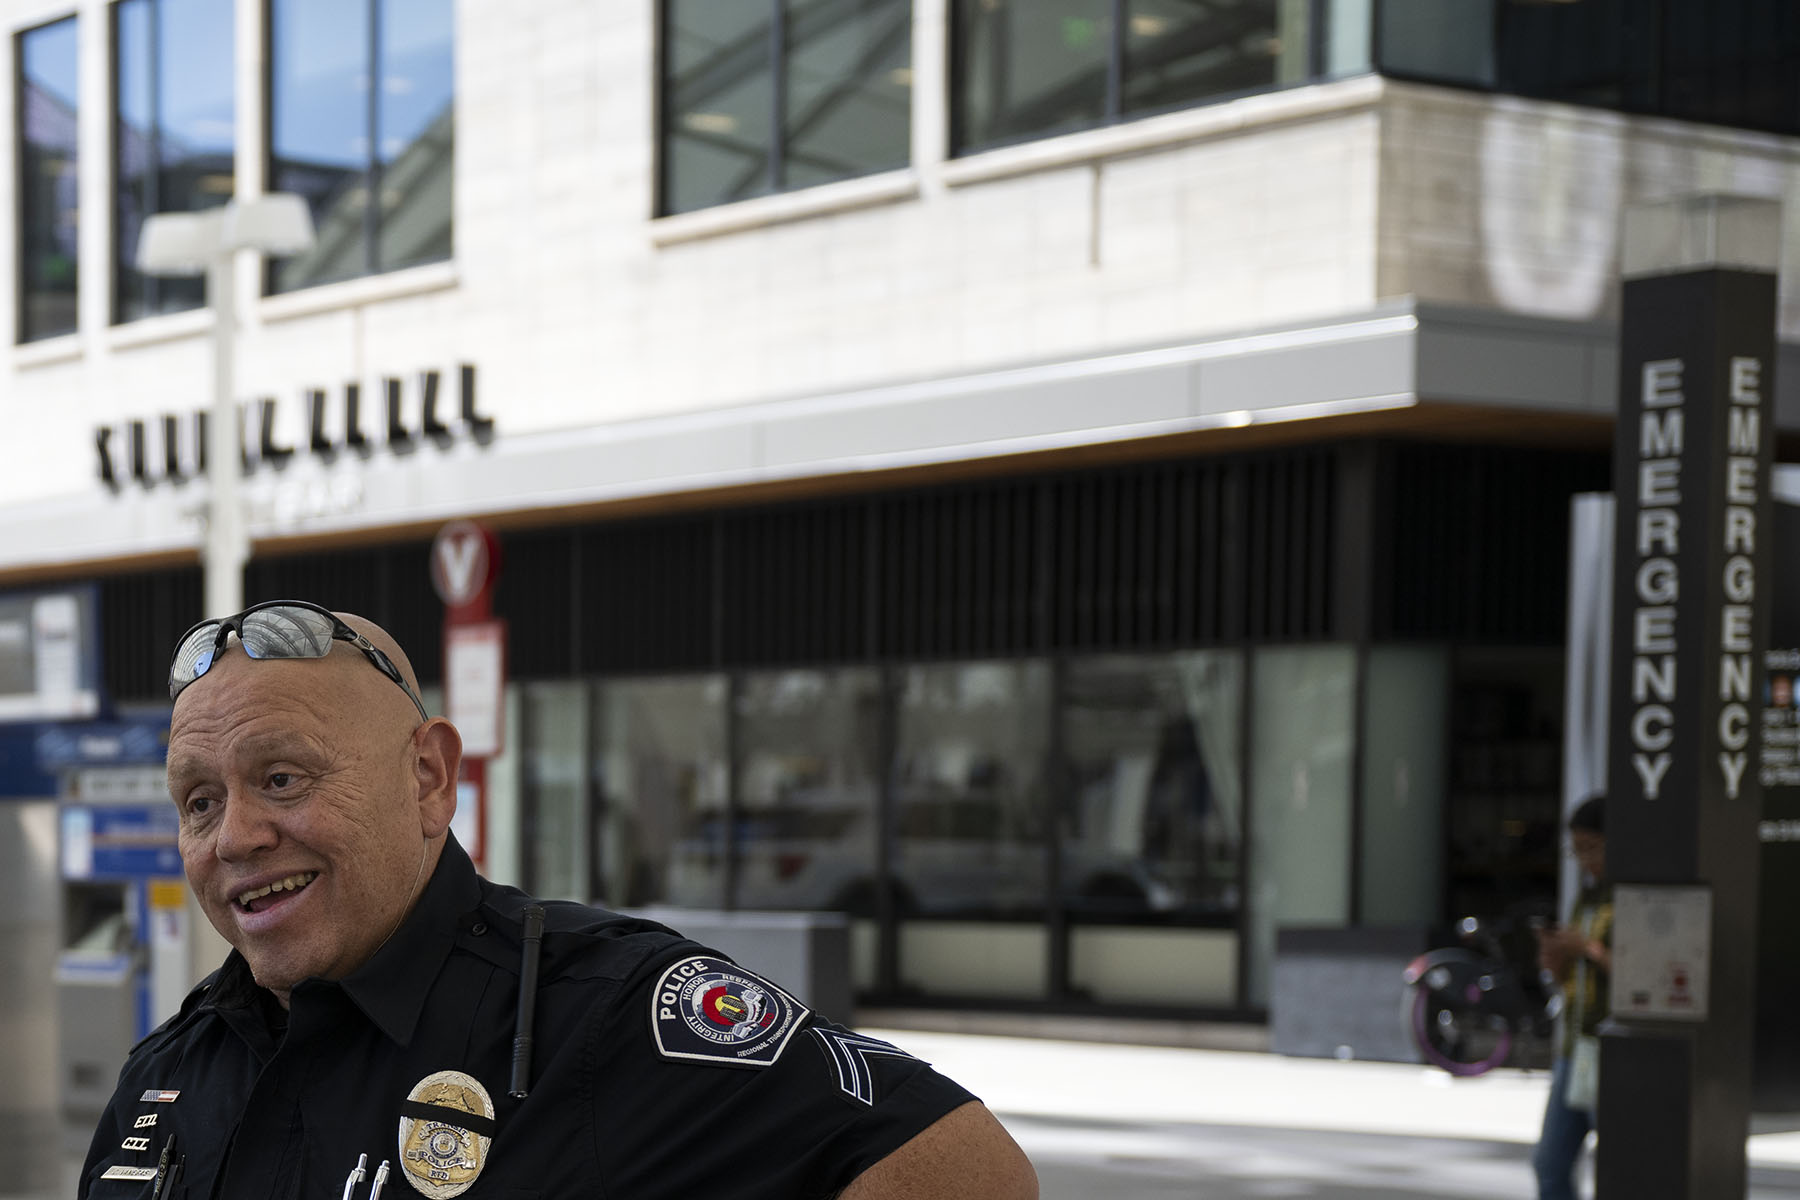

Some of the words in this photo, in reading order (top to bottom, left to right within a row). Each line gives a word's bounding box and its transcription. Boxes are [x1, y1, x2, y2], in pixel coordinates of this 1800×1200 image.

[438, 537, 482, 599] V
[1630, 357, 1686, 800] EMERGENCY
[1717, 355, 1762, 800] EMERGENCY
[660, 961, 708, 1020] POLICE
[683, 977, 707, 1001] HONOR
[722, 973, 766, 995] RESPECT
[686, 1015, 735, 1042] INTEGRITY
[737, 1041, 769, 1057] REGIONAL
[420, 1151, 464, 1167] POLICE
[430, 1170, 448, 1180] RTD
